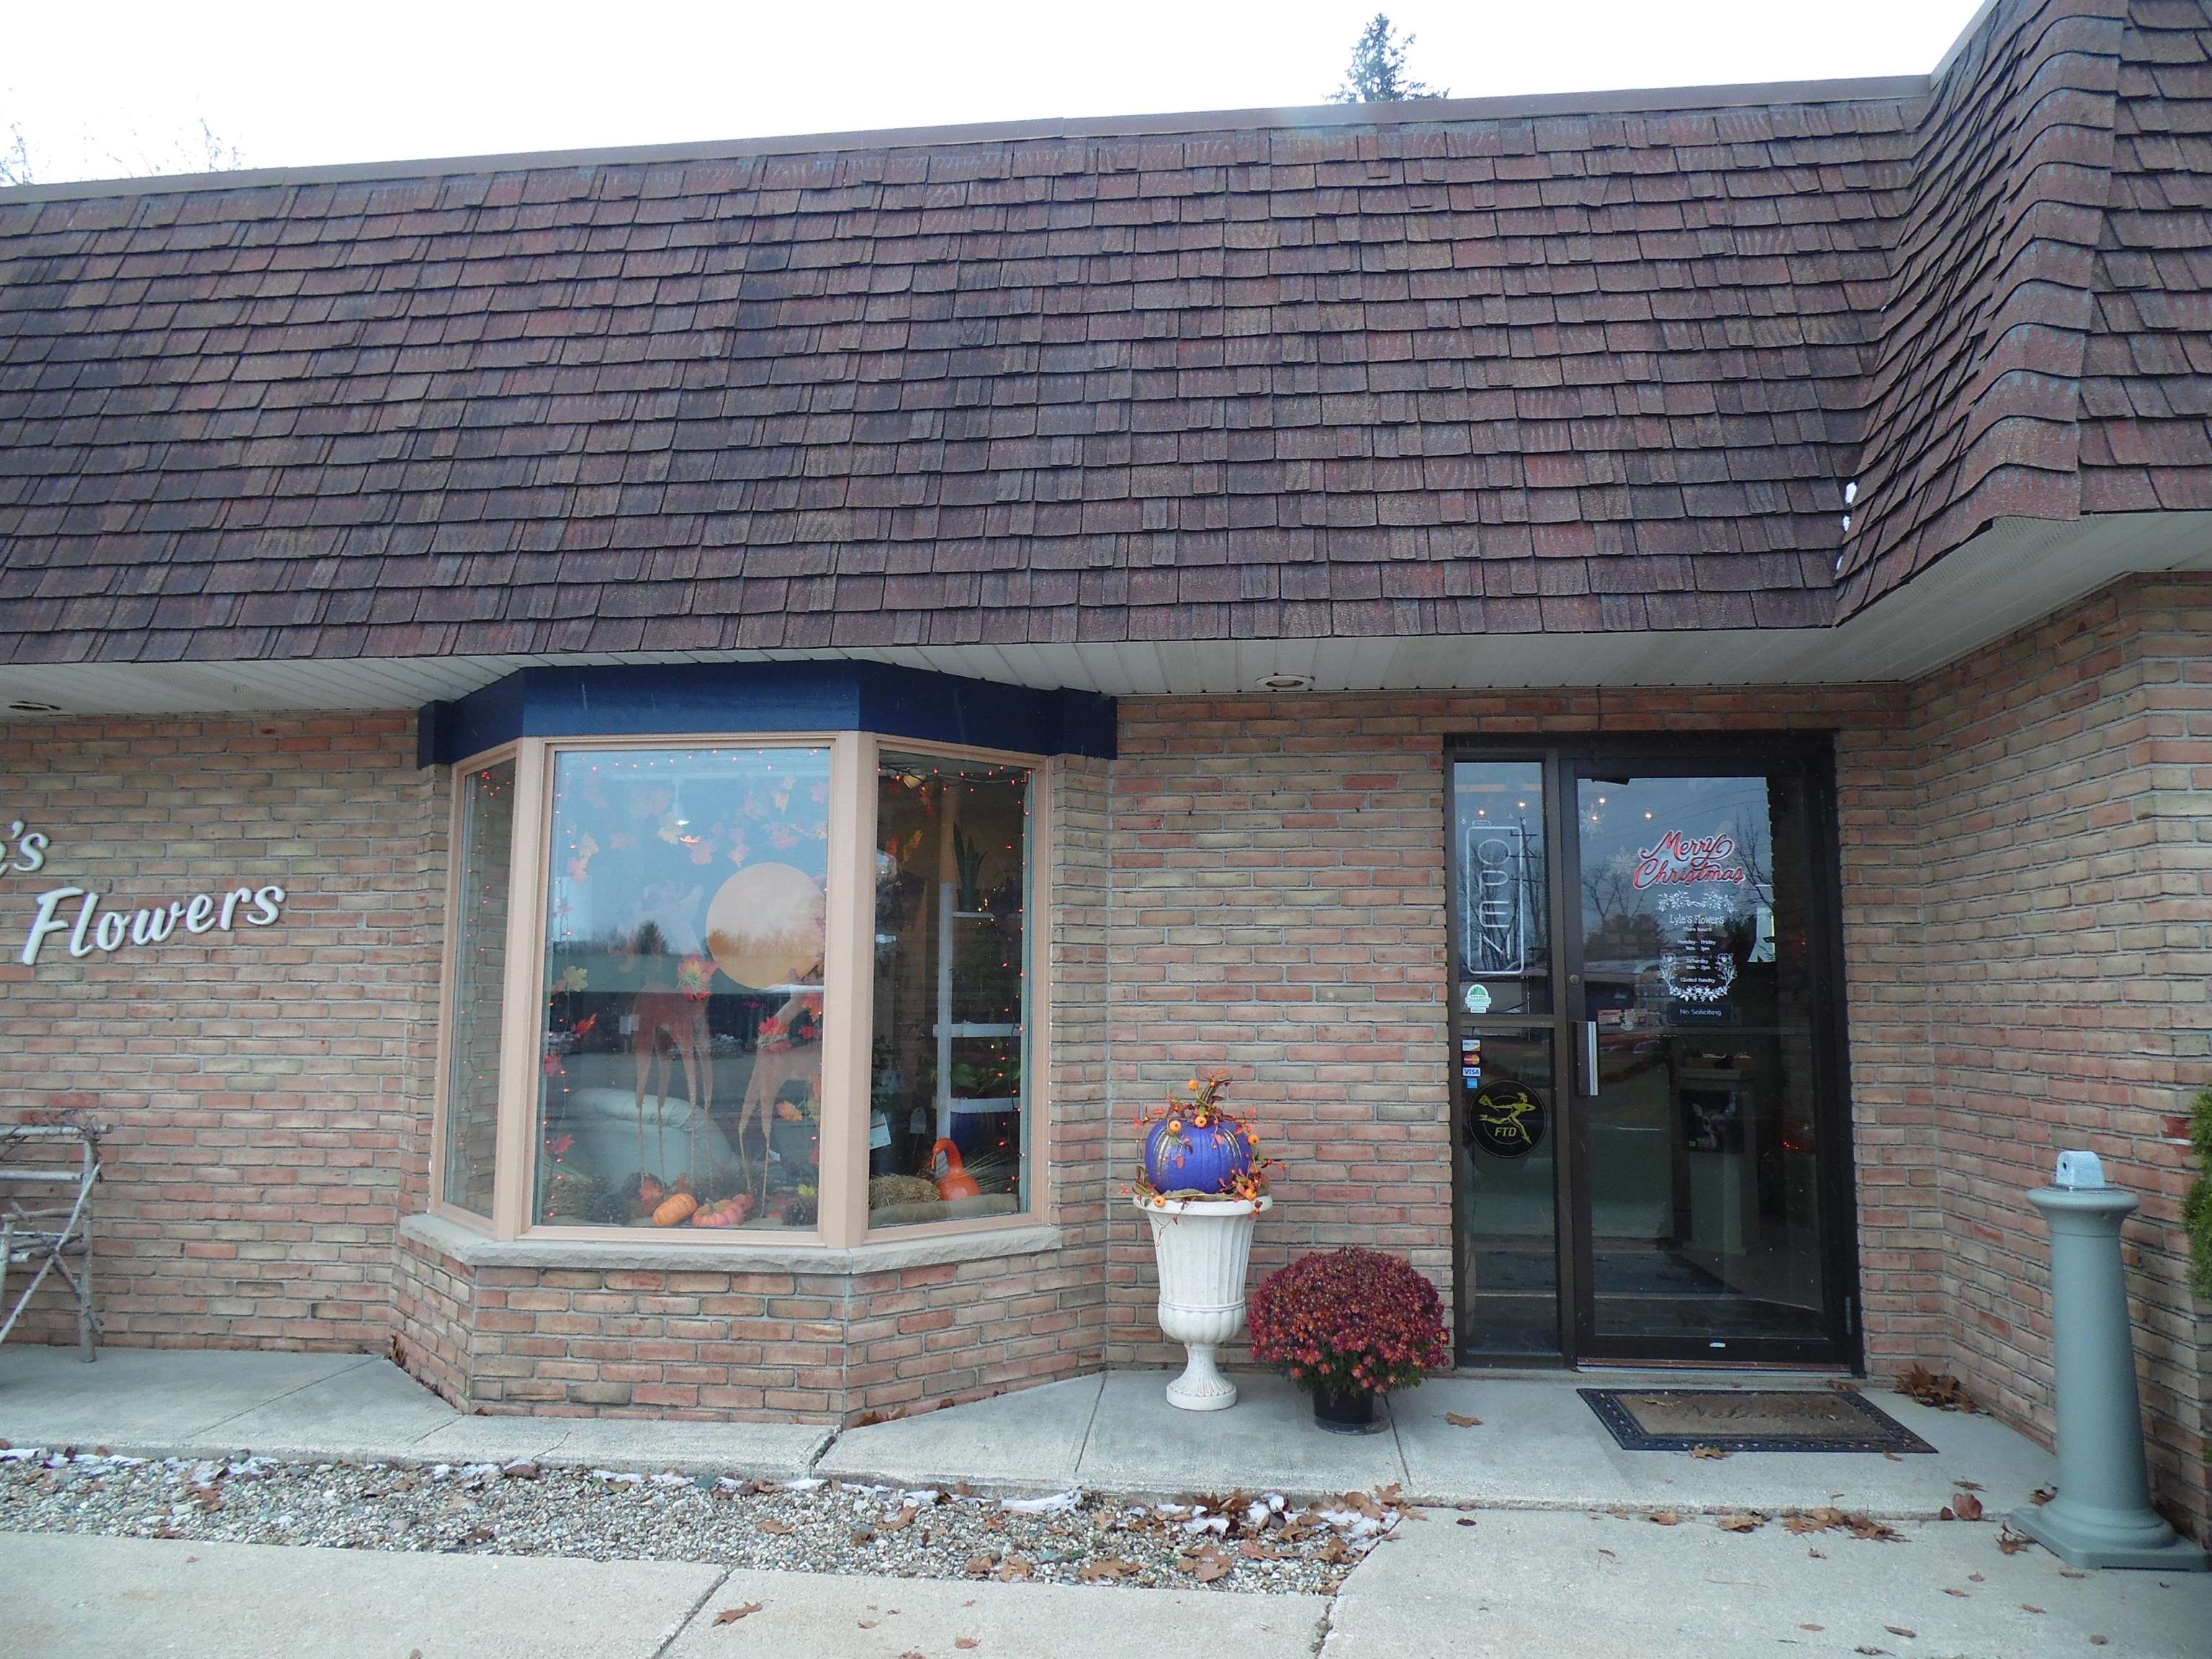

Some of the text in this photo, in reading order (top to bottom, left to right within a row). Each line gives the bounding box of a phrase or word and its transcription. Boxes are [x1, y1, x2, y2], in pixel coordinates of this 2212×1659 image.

[1639, 830, 1733, 868] Merry
[1633, 858, 1745, 889] Christmas
[1478, 839, 1511, 962] OPEN
[22, 886, 287, 966] Flowers
[1691, 1008, 1722, 1017] Soliciting
[1495, 1127, 1516, 1137] FTD
